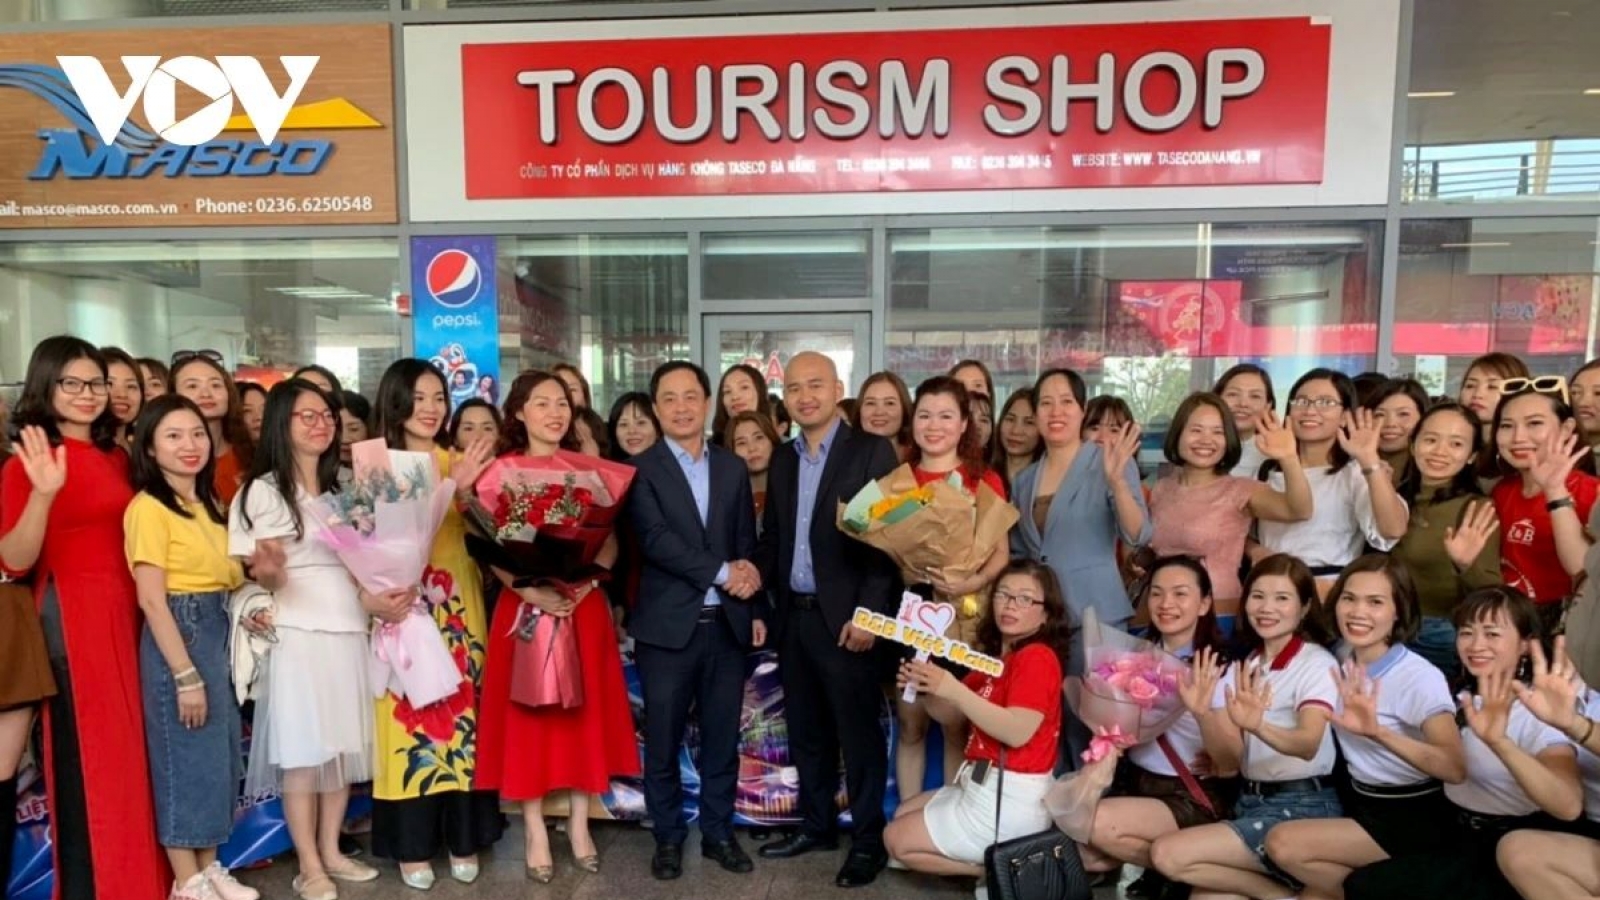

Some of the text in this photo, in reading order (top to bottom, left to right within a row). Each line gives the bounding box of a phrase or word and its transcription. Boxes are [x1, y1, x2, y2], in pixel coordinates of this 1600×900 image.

[517, 47, 1266, 144] TOURISM SHOP
[28, 128, 333, 180] MASCO
[551, 164, 564, 178] TY
[728, 159, 766, 174] TASECO
[22, 202, 178, 217] masco@masco.com.vn
[195, 198, 253, 214] Phone:
[256, 195, 373, 213] 0236.6250548
